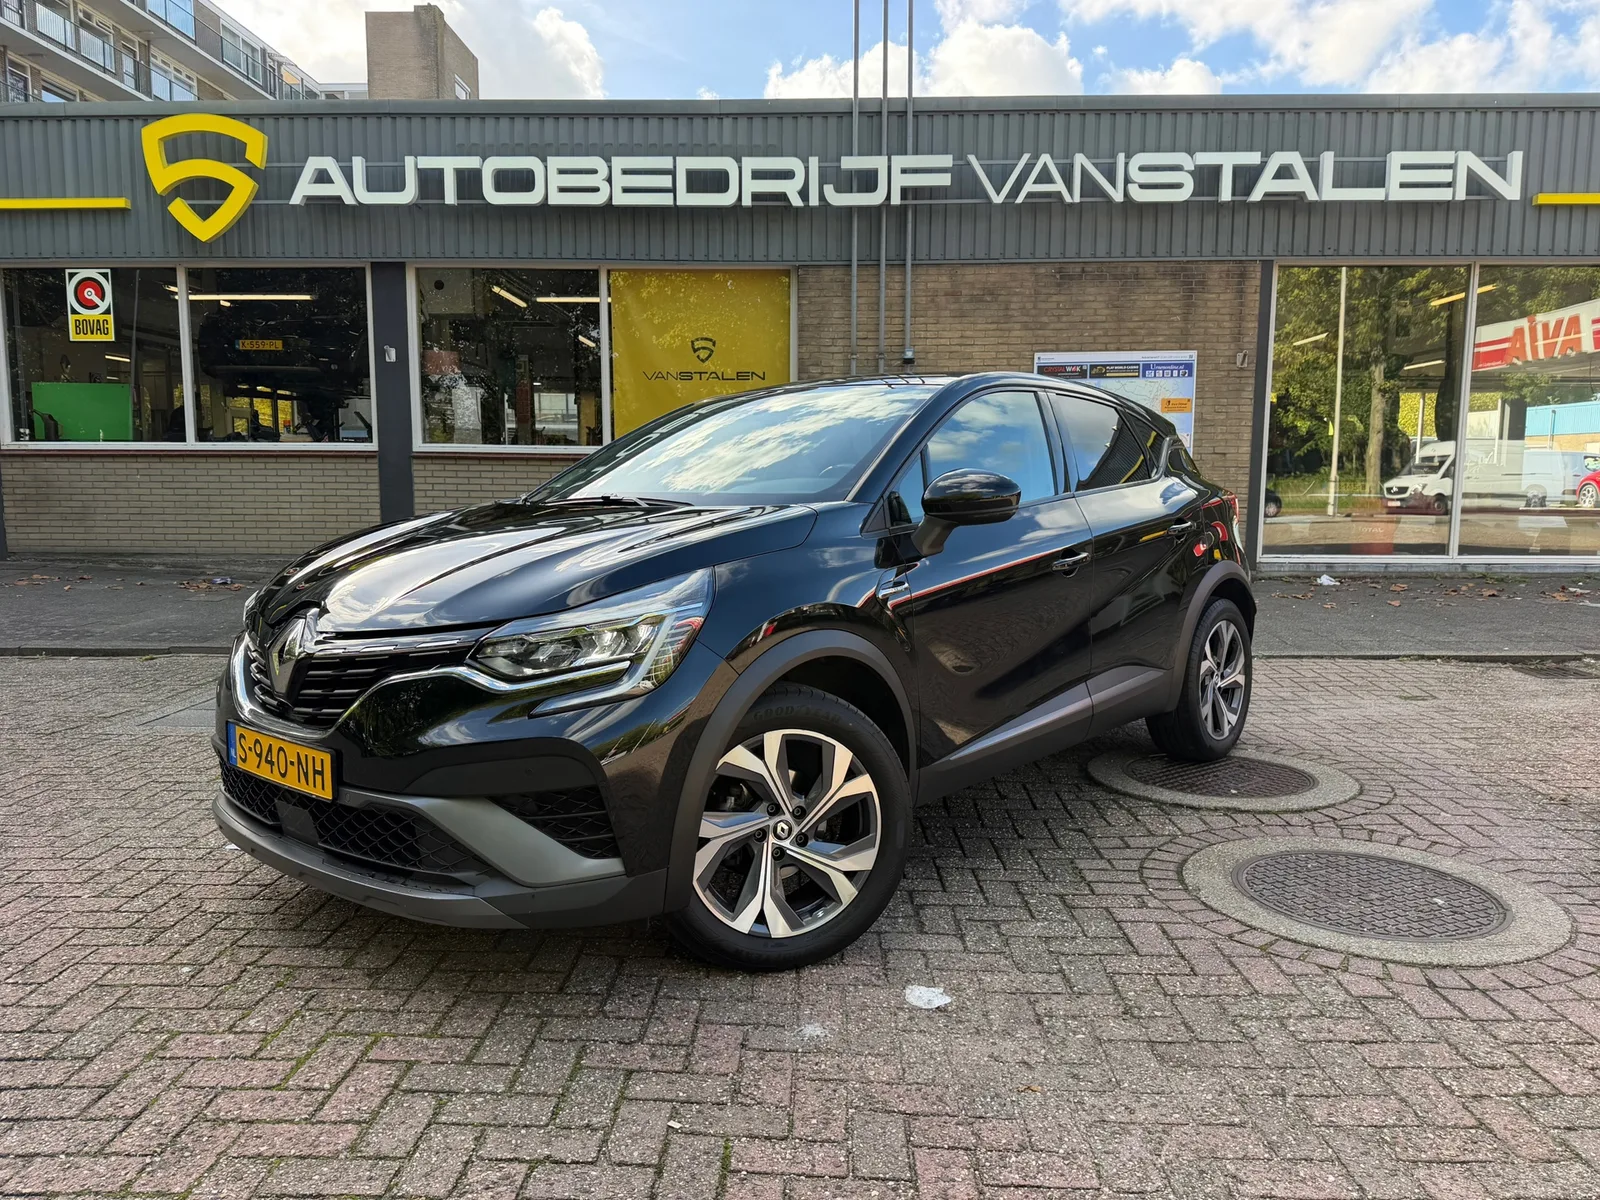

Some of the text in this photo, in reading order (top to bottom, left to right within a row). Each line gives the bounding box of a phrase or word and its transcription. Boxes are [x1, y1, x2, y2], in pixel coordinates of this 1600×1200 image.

[289, 150, 1521, 207] AUTOBEDRIJF VANSTALEN
[74, 318, 109, 336] BOVAG
[642, 370, 766, 381] VANSTALEN
[238, 732, 326, 792] S-940-NH
